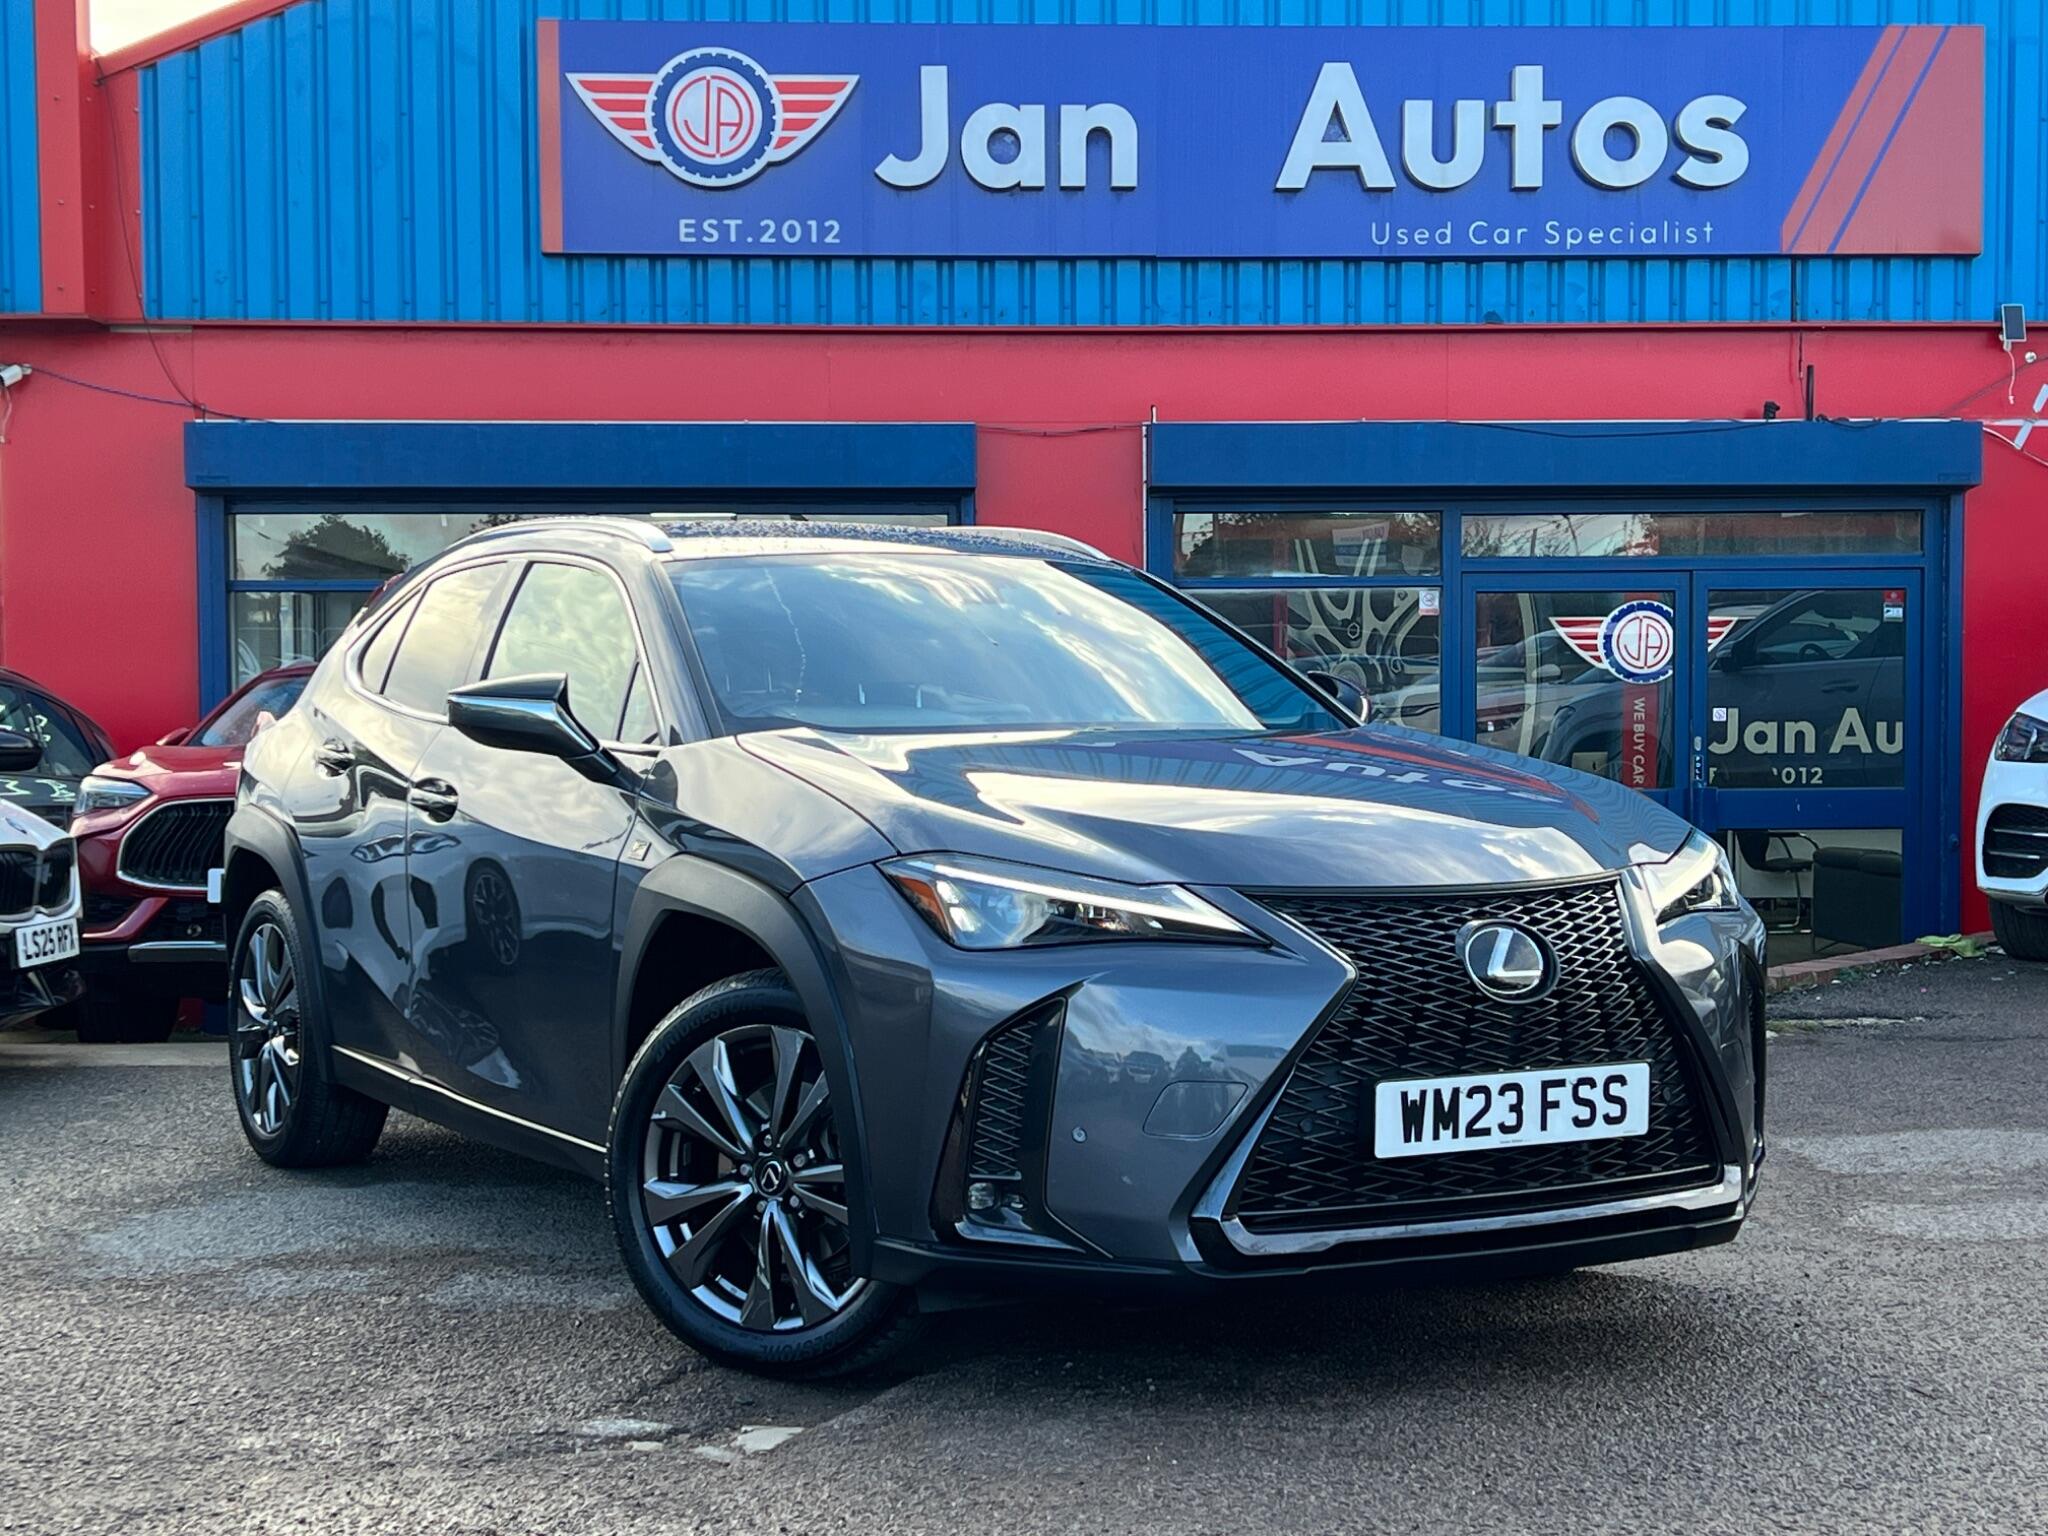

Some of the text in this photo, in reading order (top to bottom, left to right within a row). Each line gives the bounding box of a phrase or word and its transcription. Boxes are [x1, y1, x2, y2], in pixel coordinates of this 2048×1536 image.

[874, 62, 1750, 190] Jan Autos
[678, 218, 841, 245] EST.2012
[1370, 220, 1715, 250] Used Car Specialist
[1633, 697, 1646, 721] WE
[1632, 724, 1646, 752] BUY
[1707, 707, 1816, 755] Jan
[23, 927, 56, 961] LS25
[1400, 1074, 1629, 1144] WM23 FSS
